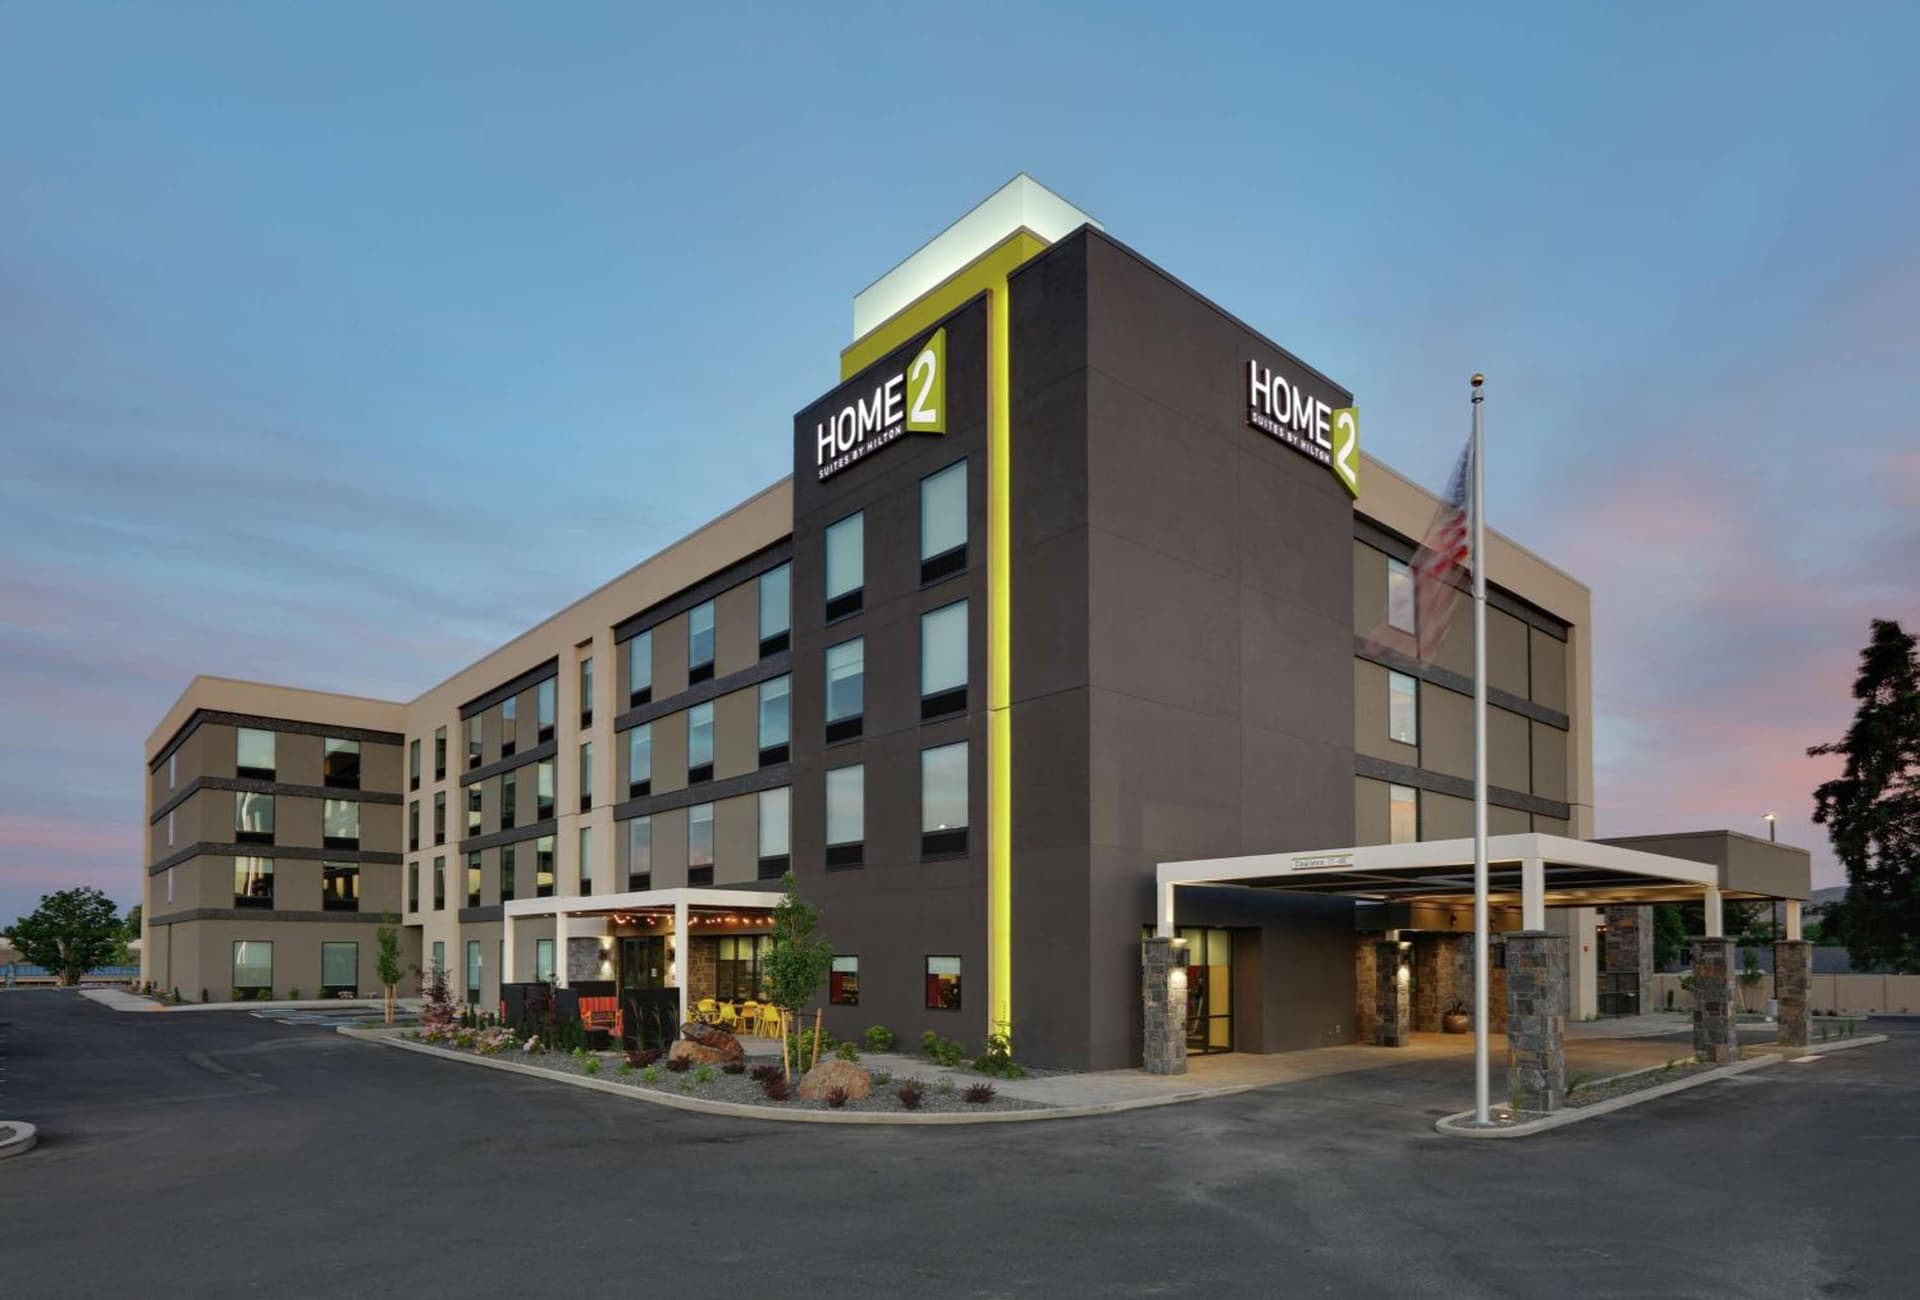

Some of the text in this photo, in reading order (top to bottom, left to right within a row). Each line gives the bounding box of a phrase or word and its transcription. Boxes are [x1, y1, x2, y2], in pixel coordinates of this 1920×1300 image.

[818, 350, 936, 465] HOME 2
[1252, 360, 1356, 485] HOME 2
[1252, 412, 1330, 464] SUITES BY HILTON
[818, 426, 902, 479] SUITES BY HILTON
